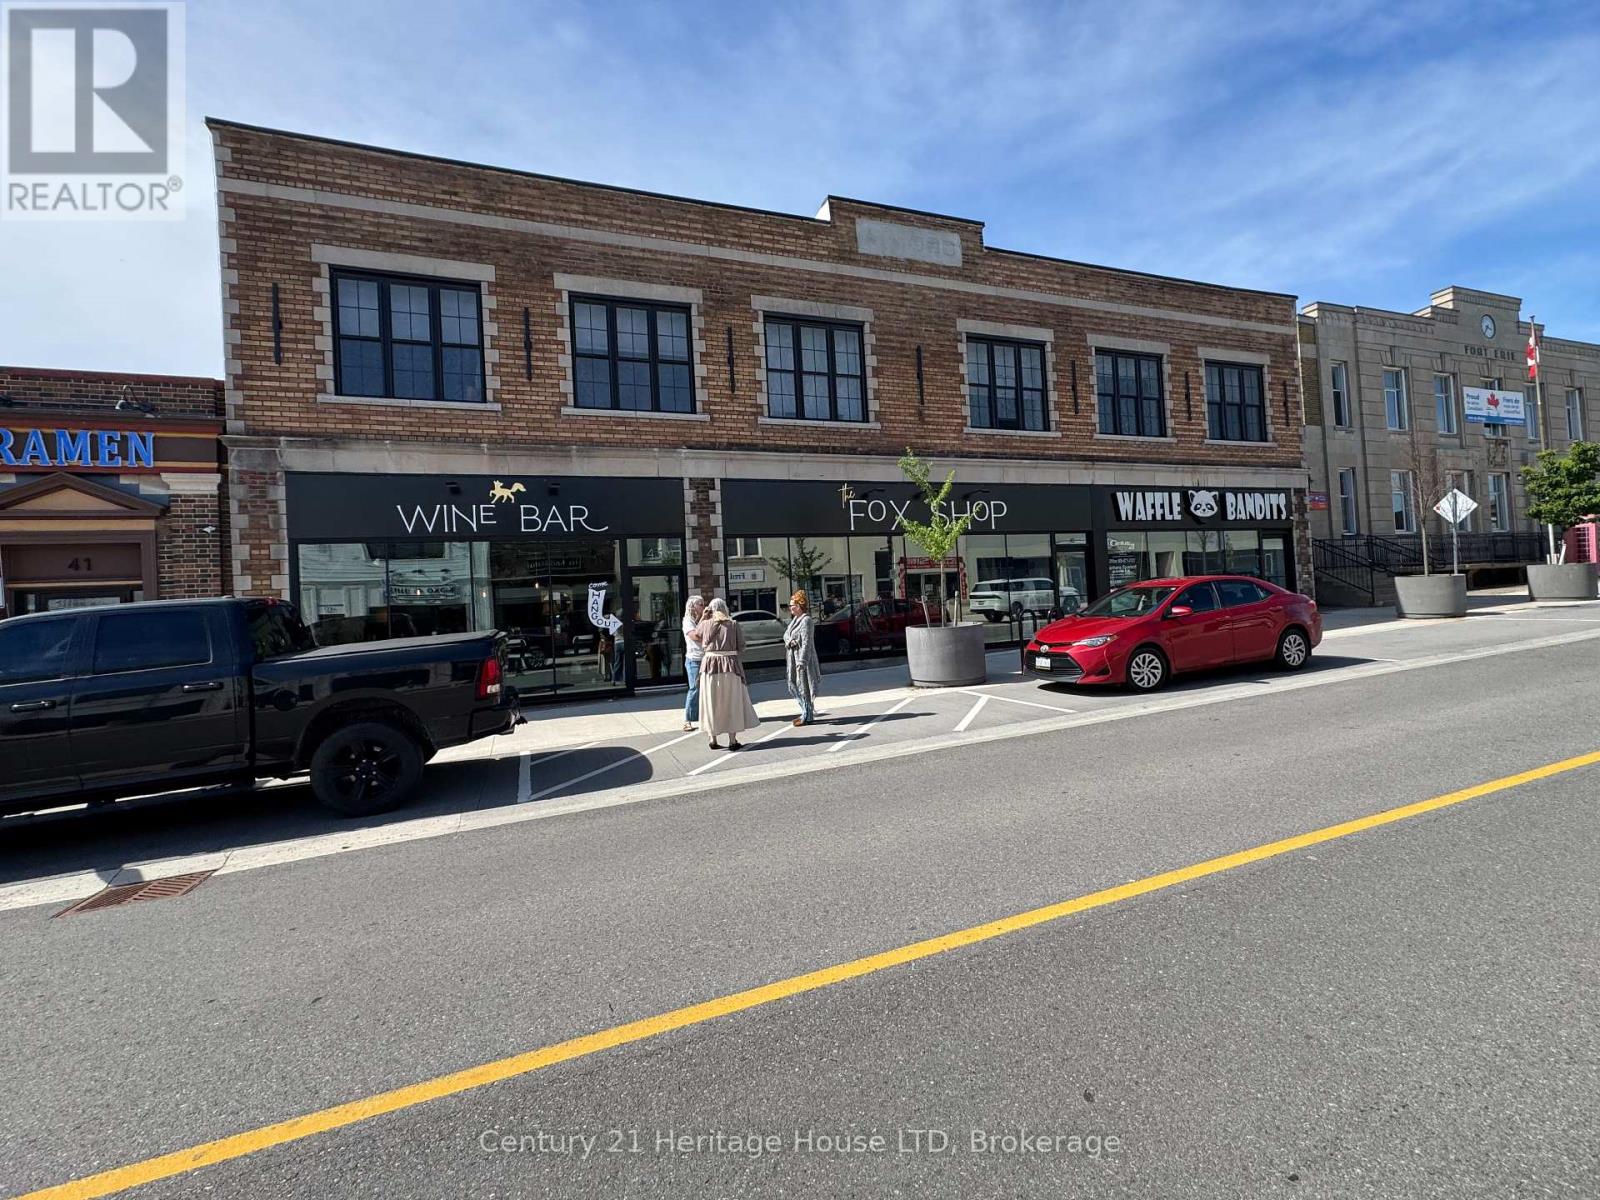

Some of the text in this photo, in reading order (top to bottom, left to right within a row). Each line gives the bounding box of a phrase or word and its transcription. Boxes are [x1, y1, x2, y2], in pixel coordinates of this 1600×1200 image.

[1464, 345, 1516, 360] FORT ERIE
[0, 427, 155, 468] RAMEN
[396, 504, 609, 534] WINE BAR
[849, 500, 1008, 531] FOX SHOP
[1116, 491, 1287, 521] WAFFLE BANDITS
[67, 557, 93, 571] 41
